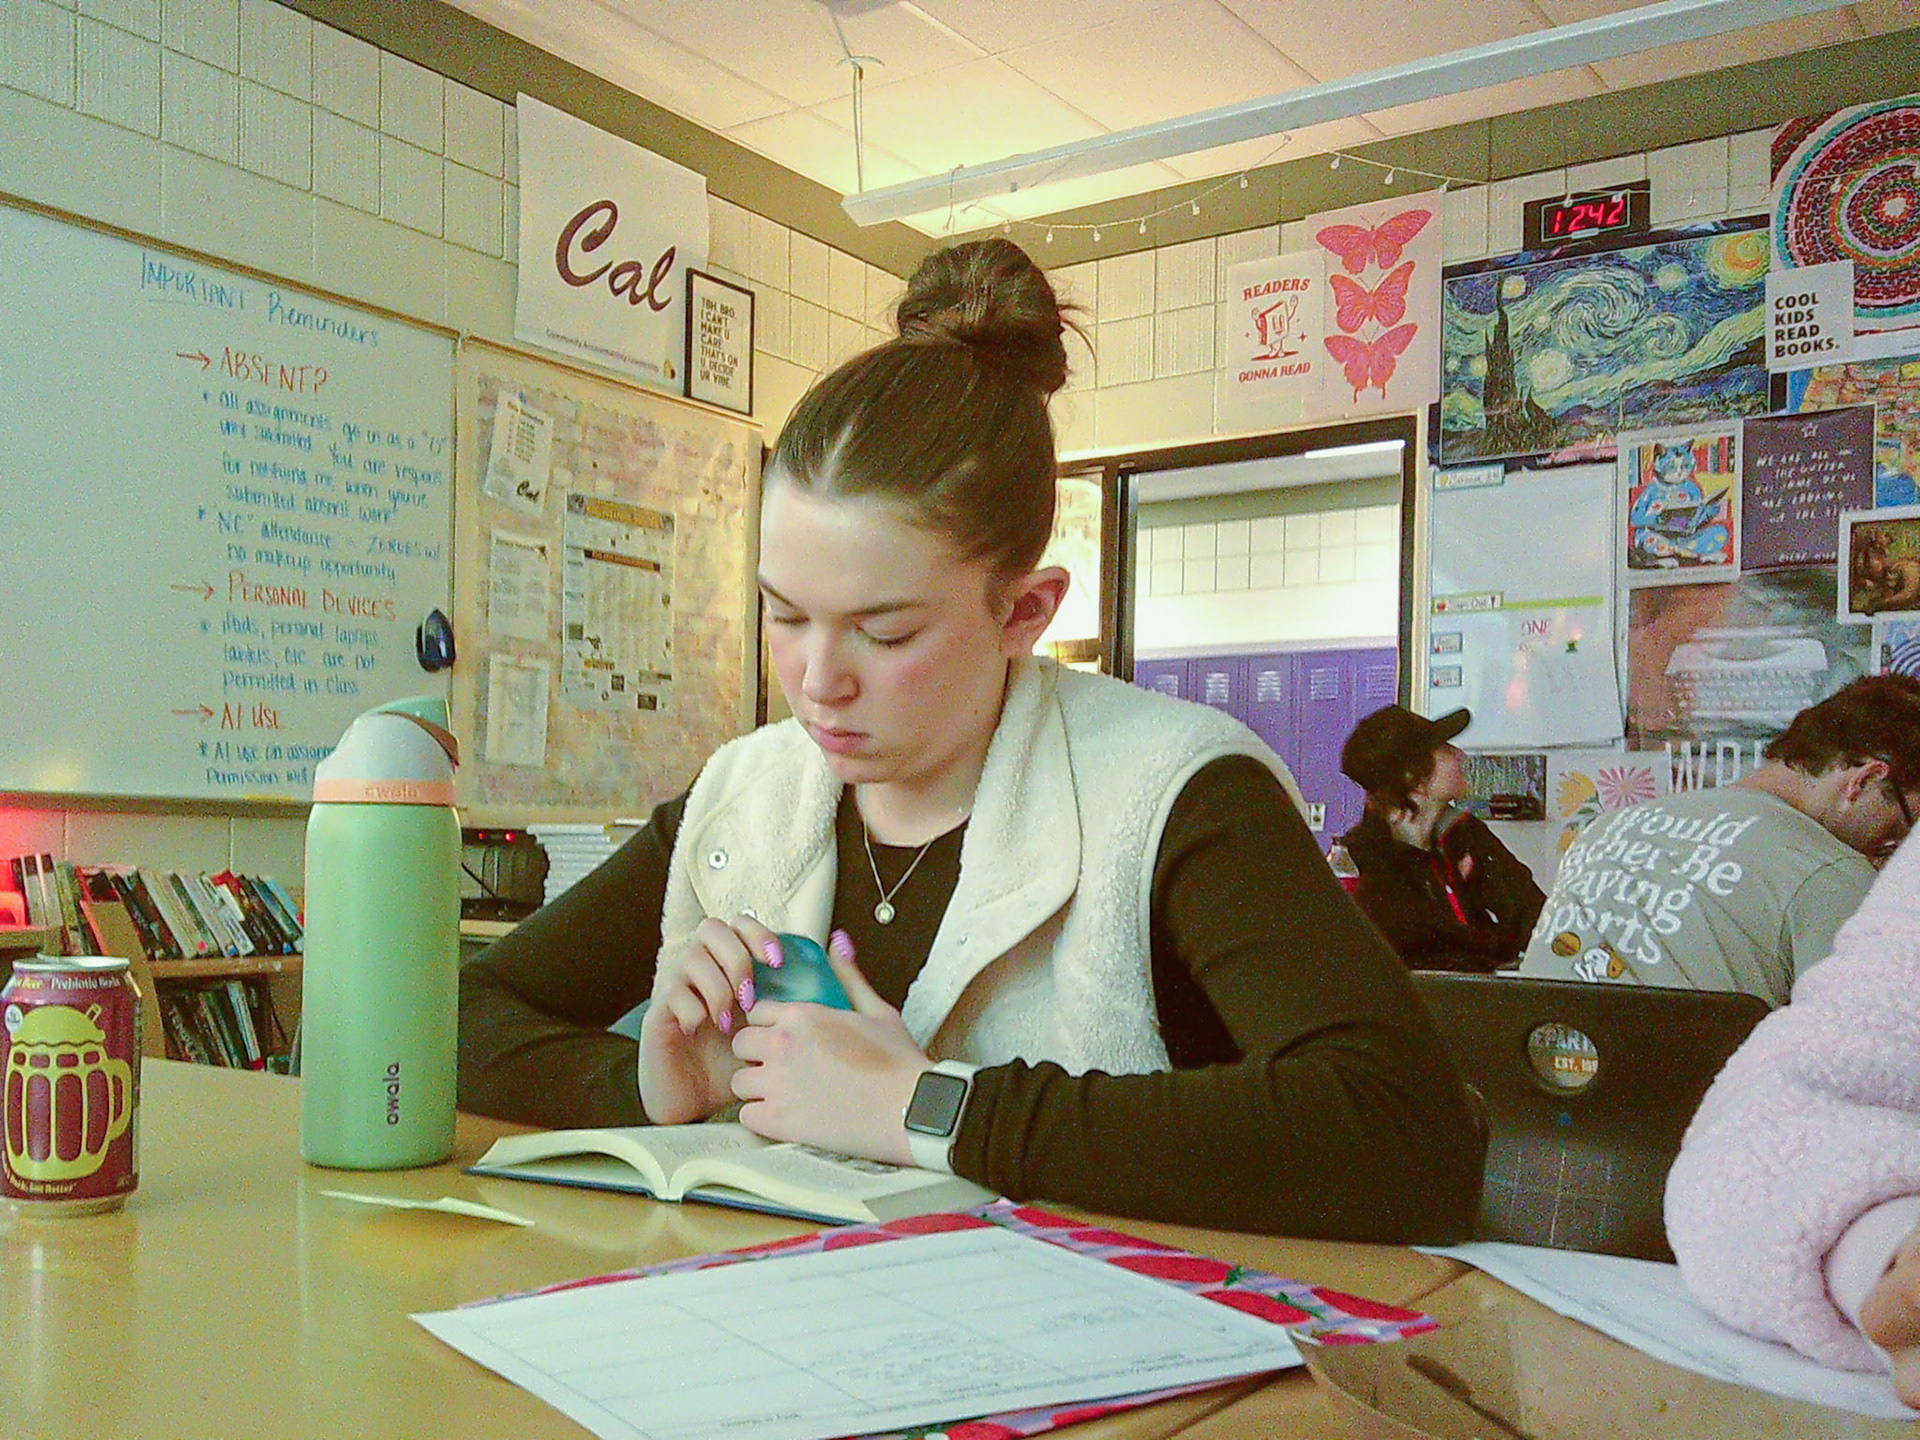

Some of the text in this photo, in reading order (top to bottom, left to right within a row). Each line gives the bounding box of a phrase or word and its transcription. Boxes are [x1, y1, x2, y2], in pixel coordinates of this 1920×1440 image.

[556, 200, 676, 312] Cal
[1243, 278, 1311, 301] READERS
[1775, 291, 1820, 311] COOL
[1775, 309, 1815, 327] KIDS
[701, 322, 722, 335] MAKE
[1775, 325, 1820, 342] READ
[1775, 337, 1840, 359] BOOKS.
[220, 346, 327, 393] ABSENT?
[727, 354, 738, 367] ON
[700, 369, 710, 382] UR
[1239, 362, 1311, 383] GONNA READ
[322, 651, 344, 667] are
[221, 702, 241, 731] AI
[365, 785, 419, 800] owala
[1672, 846, 1743, 897] Be
[384, 1062, 401, 1126] owala
